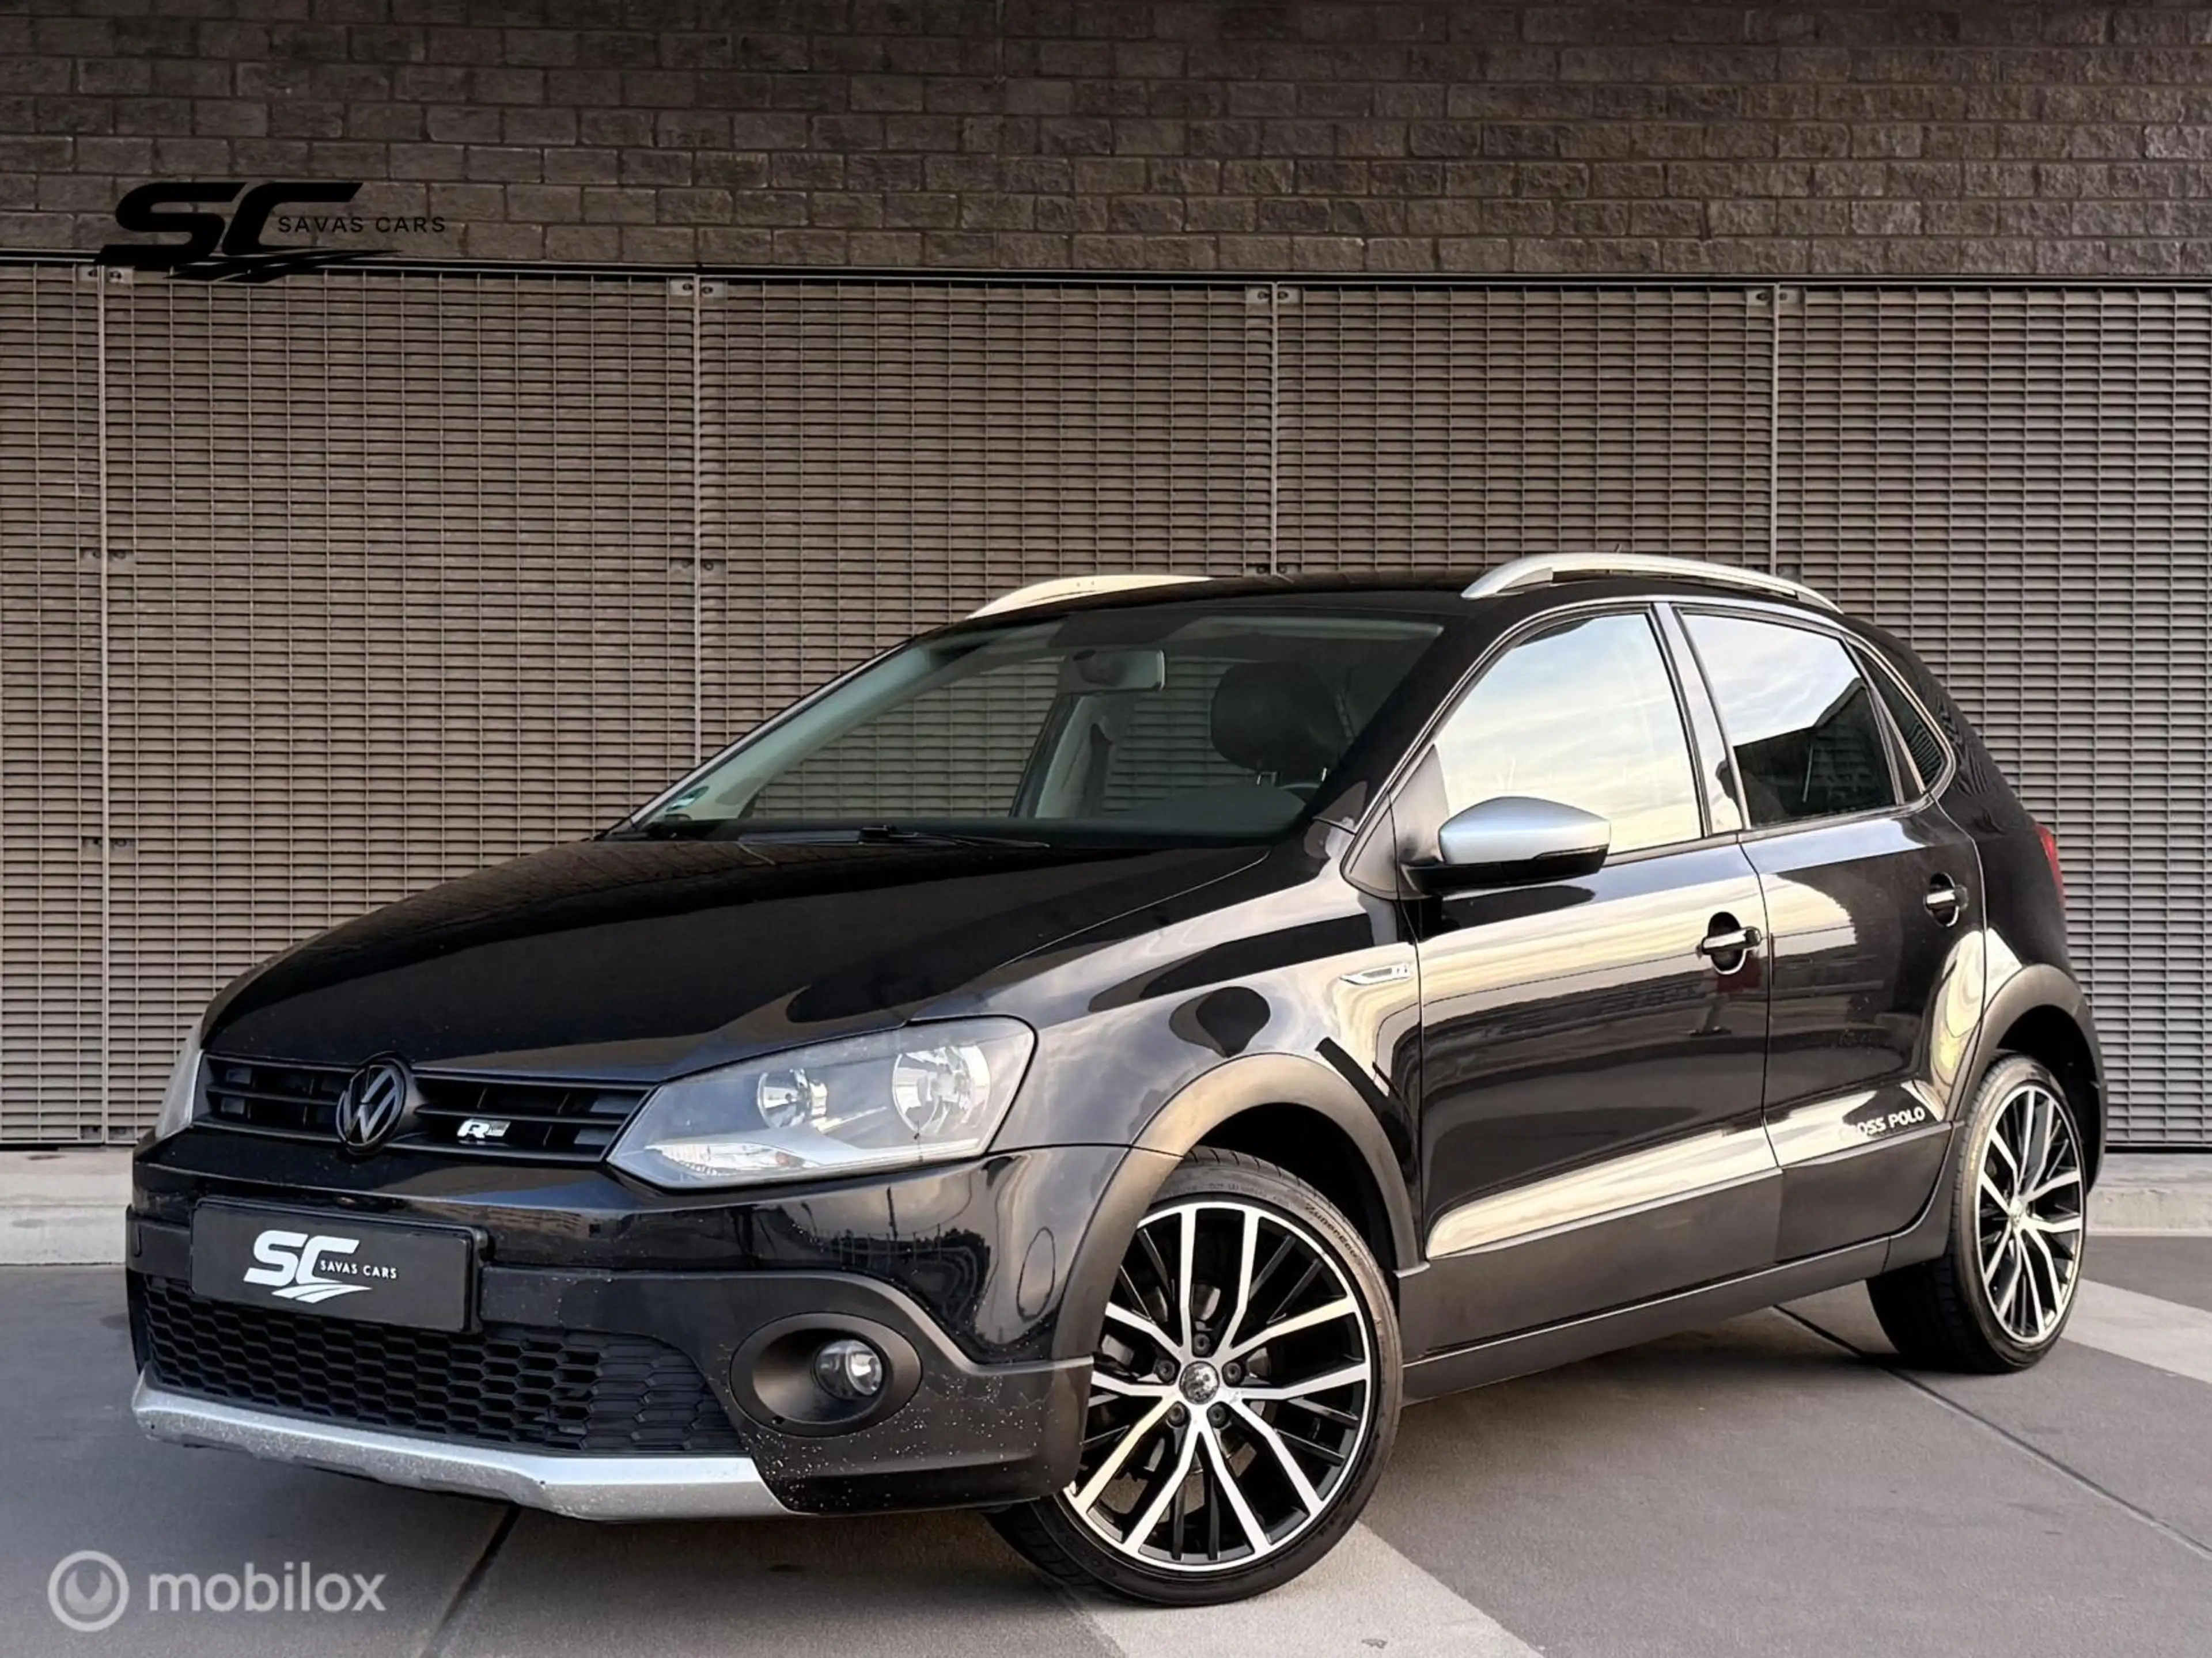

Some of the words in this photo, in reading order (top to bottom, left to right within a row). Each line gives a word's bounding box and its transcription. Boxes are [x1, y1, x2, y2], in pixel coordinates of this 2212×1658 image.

[1888, 1106, 1926, 1128] POLO
[243, 1230, 359, 1286] SC
[320, 1259, 358, 1275] SAVAS
[363, 1265, 397, 1279] CARS
